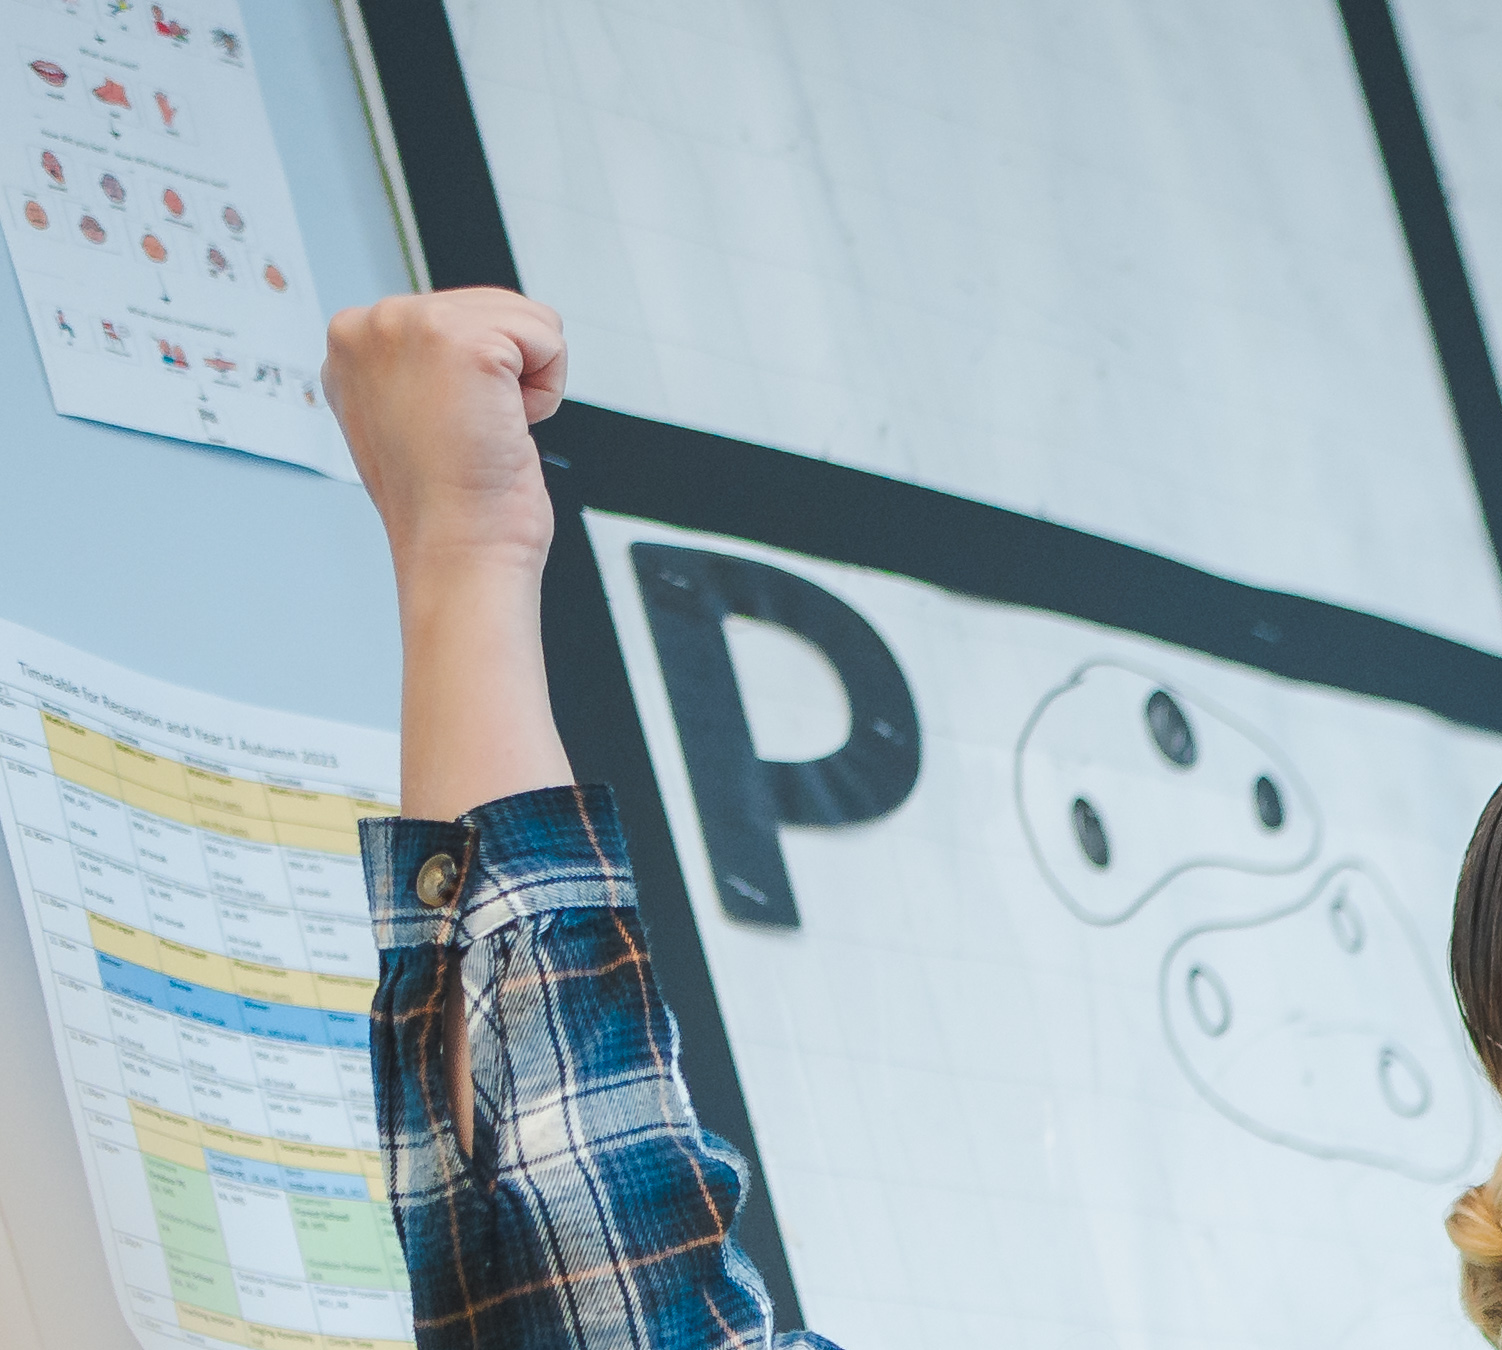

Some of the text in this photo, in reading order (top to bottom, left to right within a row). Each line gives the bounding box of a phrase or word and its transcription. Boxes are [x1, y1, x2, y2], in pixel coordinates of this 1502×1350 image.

[18, 660, 80, 698] Timetable
[81, 686, 99, 703] for
[166, 720, 192, 739] and
[629, 541, 923, 932] P
